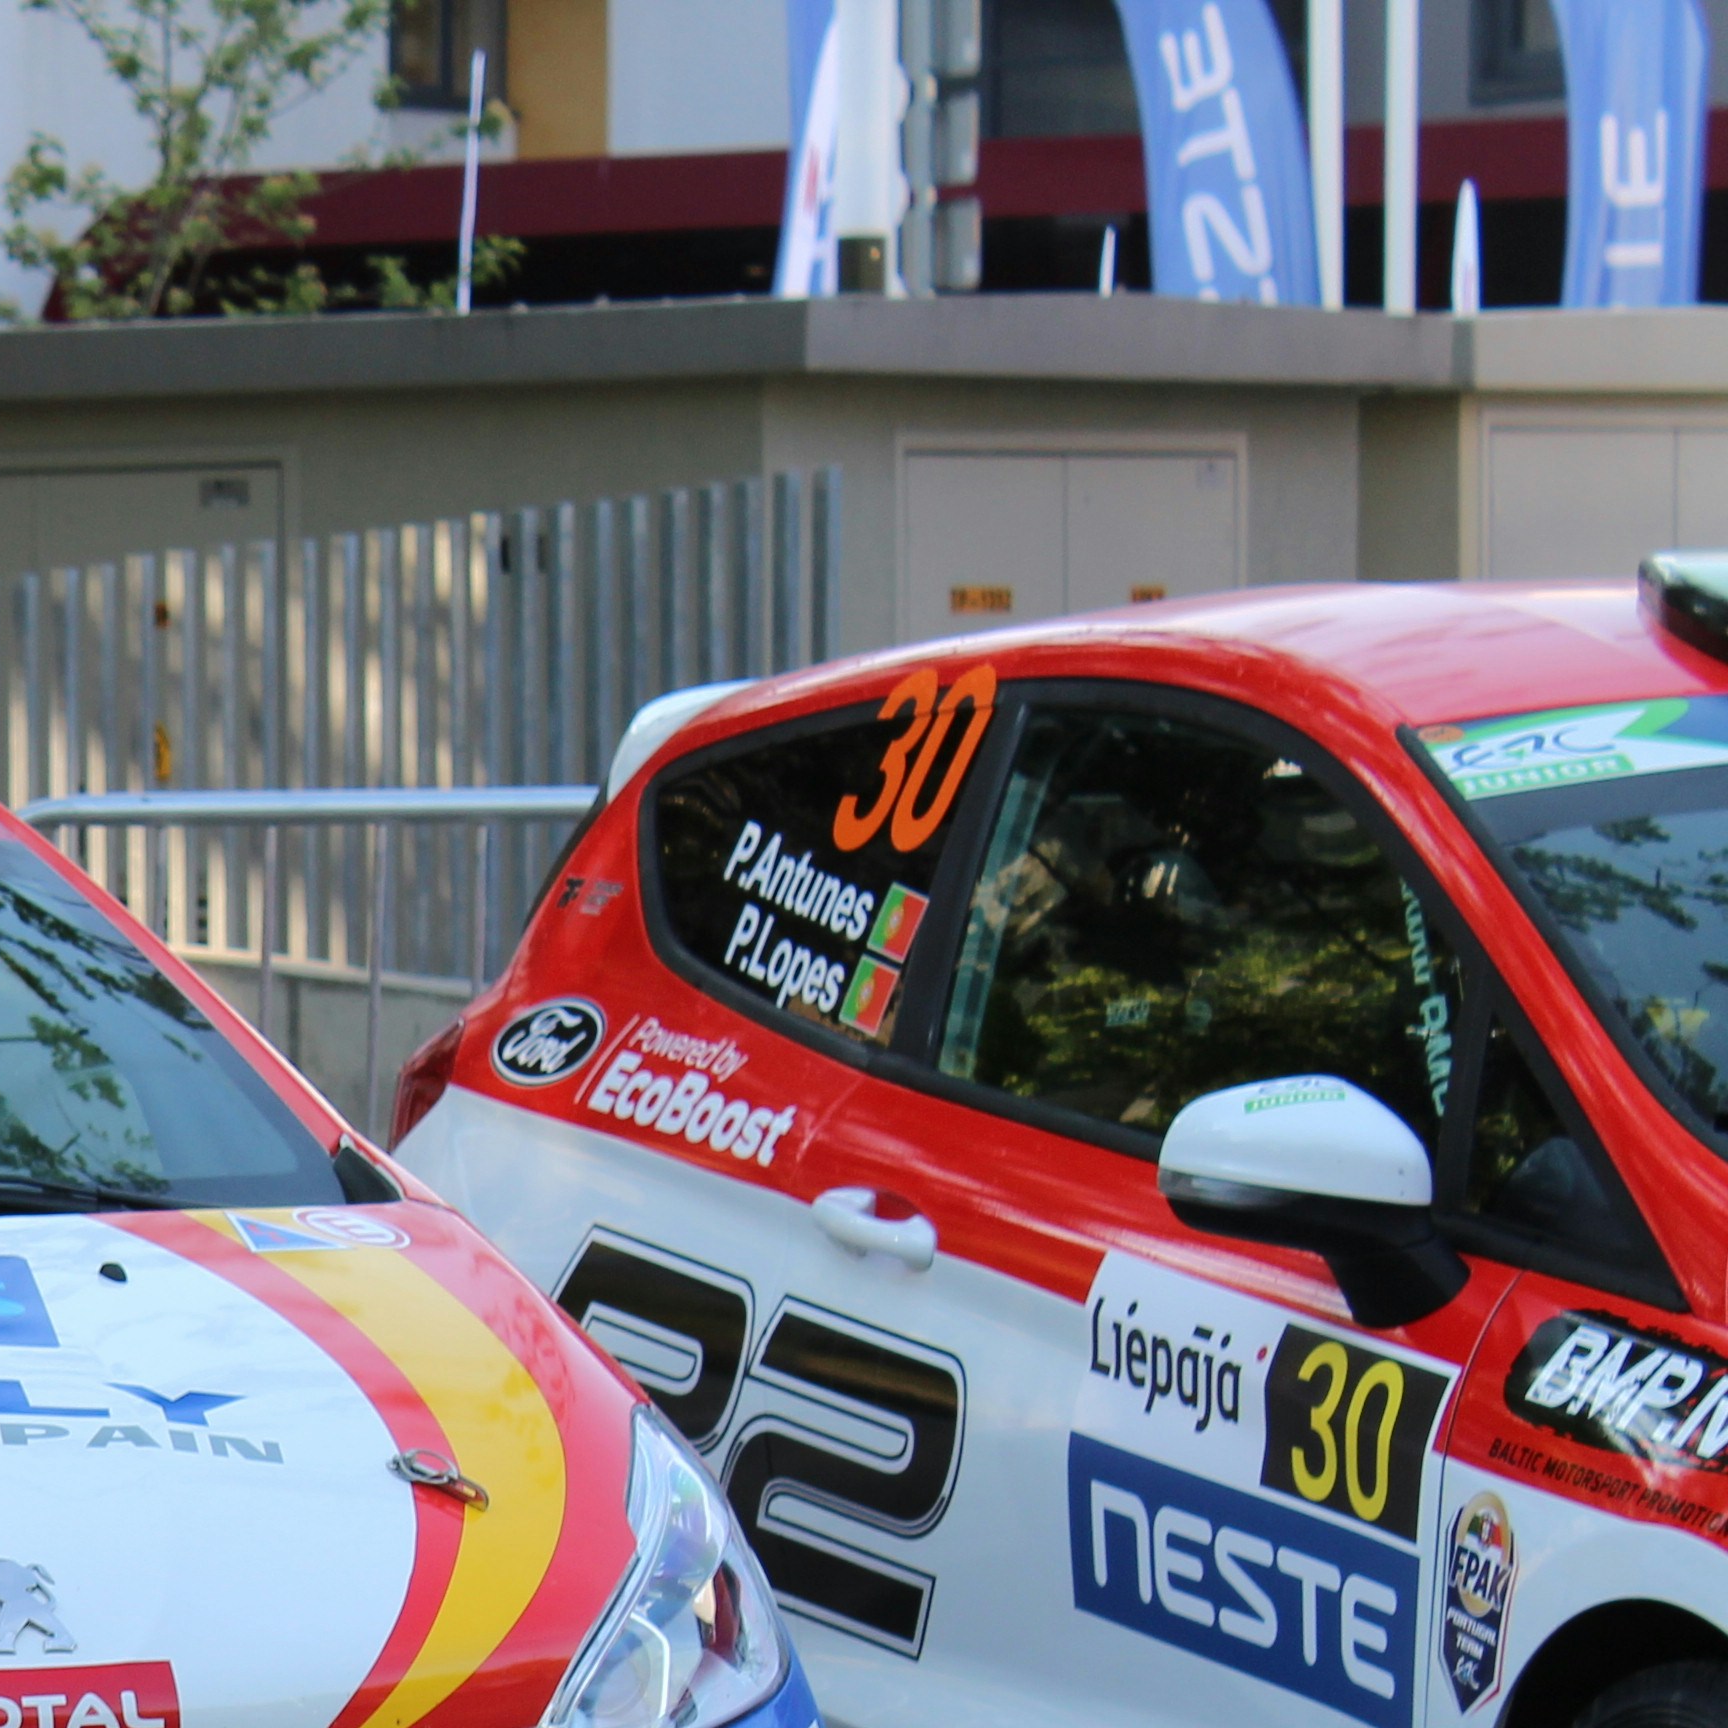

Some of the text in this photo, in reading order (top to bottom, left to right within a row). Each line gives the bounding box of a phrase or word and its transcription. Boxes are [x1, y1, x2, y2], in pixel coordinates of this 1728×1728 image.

[833, 665, 997, 852] 30
[1465, 758, 1621, 793] JUNIOR
[725, 820, 874, 943] P.Antunes
[725, 904, 845, 1014] P.Lopes
[503, 1007, 587, 1074] Ford
[629, 1016, 748, 1083] Powered by
[587, 1050, 796, 1168] EcoBoost
[1090, 1296, 1243, 1434] Liepāja
[1291, 1341, 1404, 1522] 30
[1488, 1437, 1545, 1474] BALTIC
[1541, 1456, 1642, 1502] MOTORSPORT
[1090, 1478, 1398, 1701] NESTE
[1449, 1546, 1511, 1612] FPAK
[1446, 1606, 1497, 1648] PORTUGAL
[1455, 1631, 1484, 1661] TEAM
